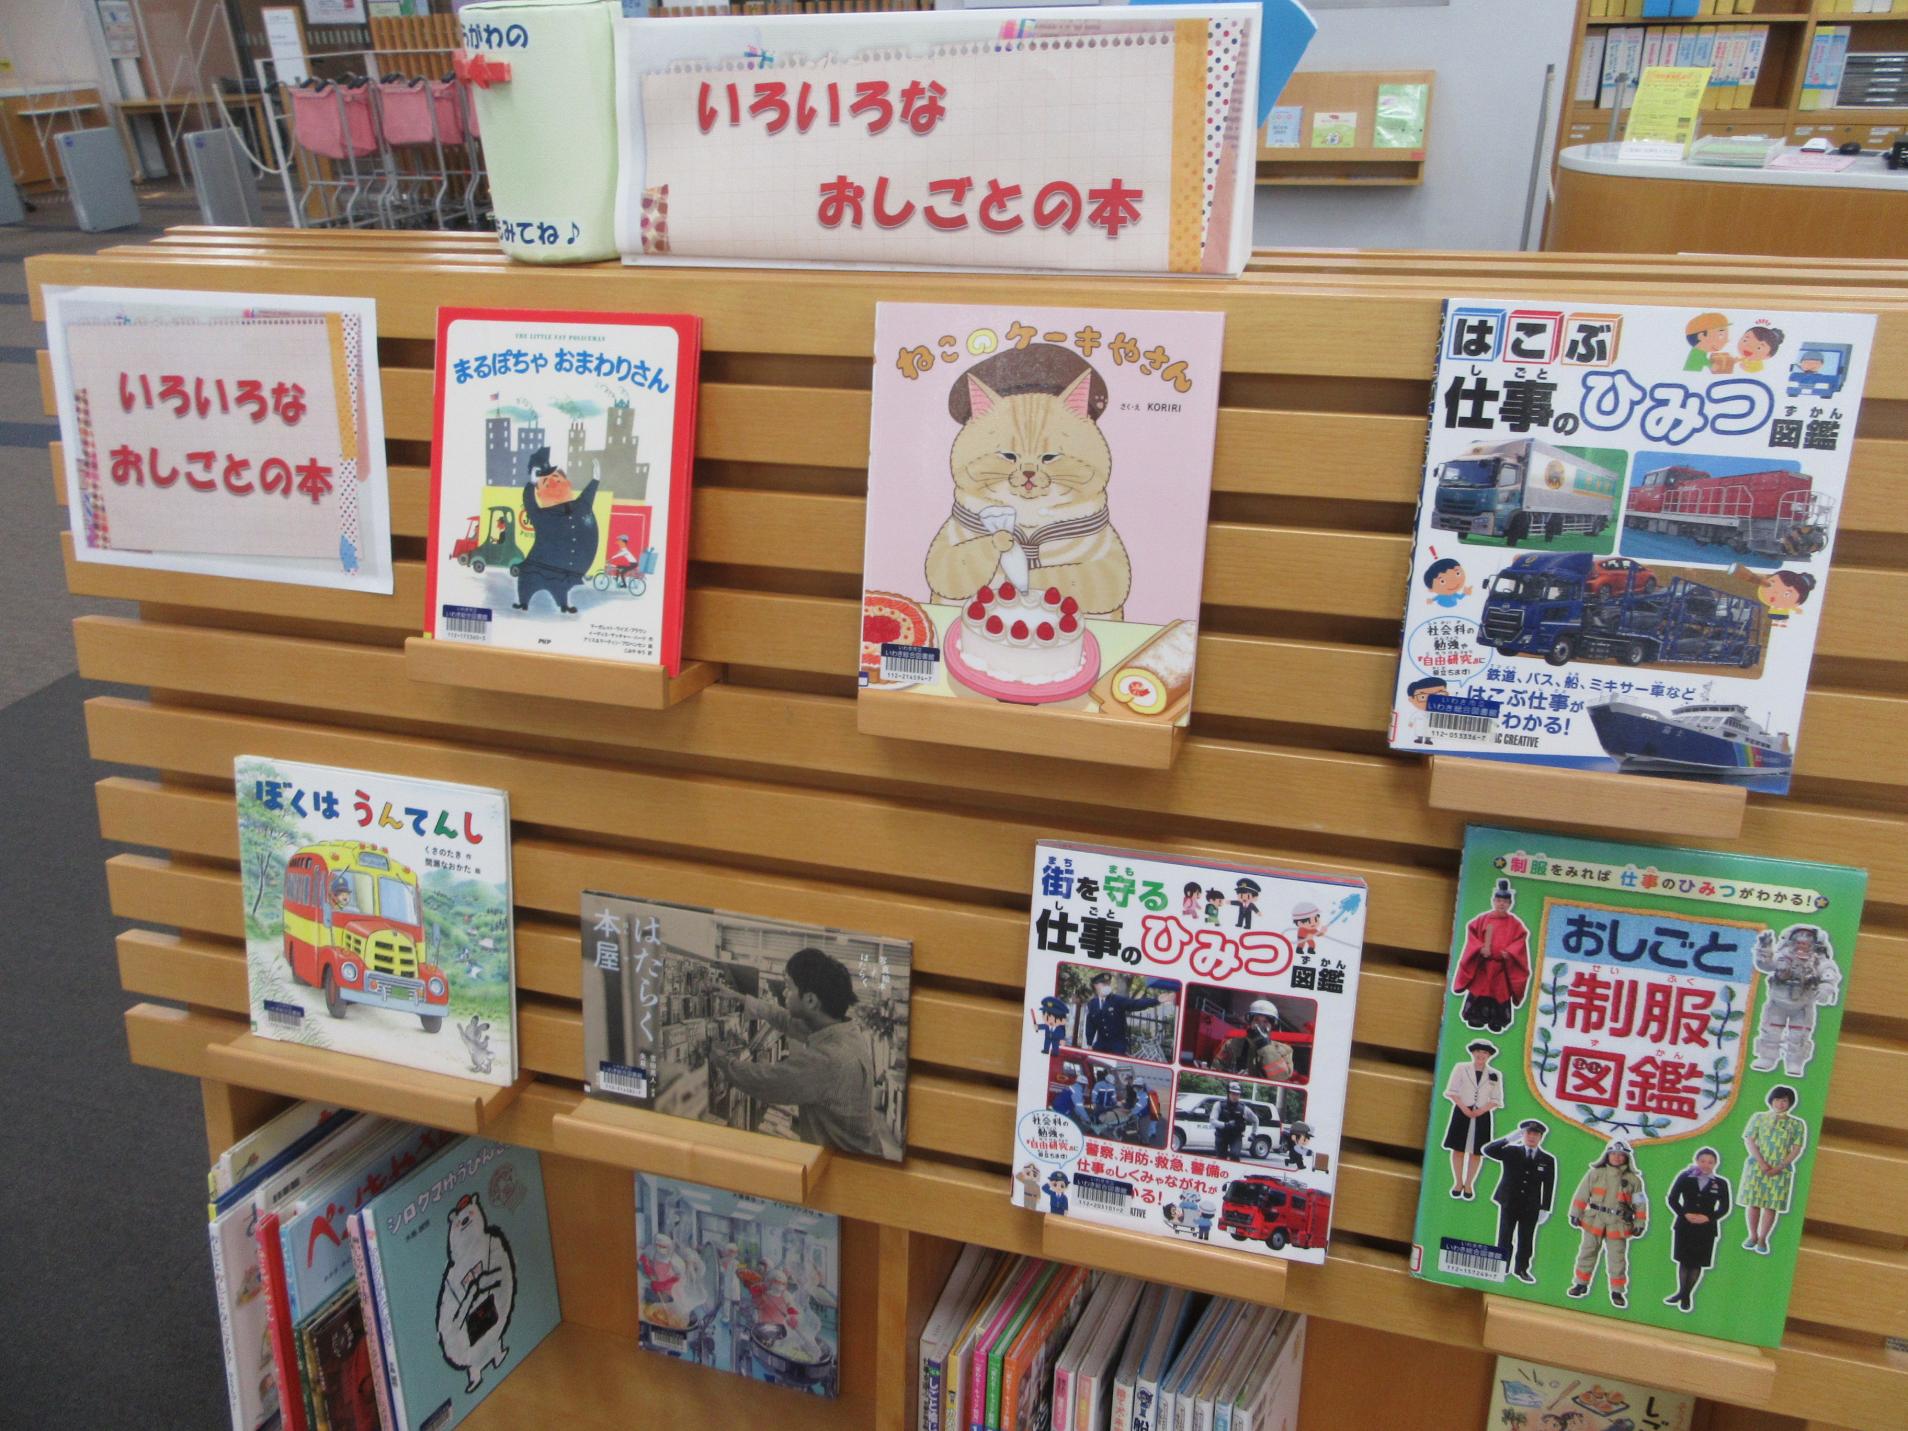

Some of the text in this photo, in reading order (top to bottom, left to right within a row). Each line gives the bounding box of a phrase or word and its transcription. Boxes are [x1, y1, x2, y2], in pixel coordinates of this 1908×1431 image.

[698, 79, 948, 136] いろいろな
[817, 174, 1144, 239] おしごとの本
[896, 321, 1193, 393] ねこのケーキやさん
[1453, 317, 1612, 364] はこぶ
[119, 371, 308, 427] いろいろな
[453, 347, 669, 394] まるぽちゃ おまわりさん
[1147, 403, 1182, 413] KORIRI
[109, 443, 334, 506] おしごとの本
[1427, 624, 1474, 636] 社会科の
[1504, 734, 1539, 748] CREATIVE
[256, 780, 484, 845] ぼくは うんてんし
[1041, 864, 1169, 912] 街を守る
[1510, 856, 1813, 907] 制服をみれば 仕事のひみつがわかる!
[593, 908, 621, 973] 本屋
[1562, 914, 1738, 976] おしごと
[634, 917, 664, 1042] はたらく
[1565, 971, 1716, 1049] 制服
[1556, 1045, 1705, 1121] 図鑑
[1077, 1157, 1218, 1195] 仕事のしくみやながれが
